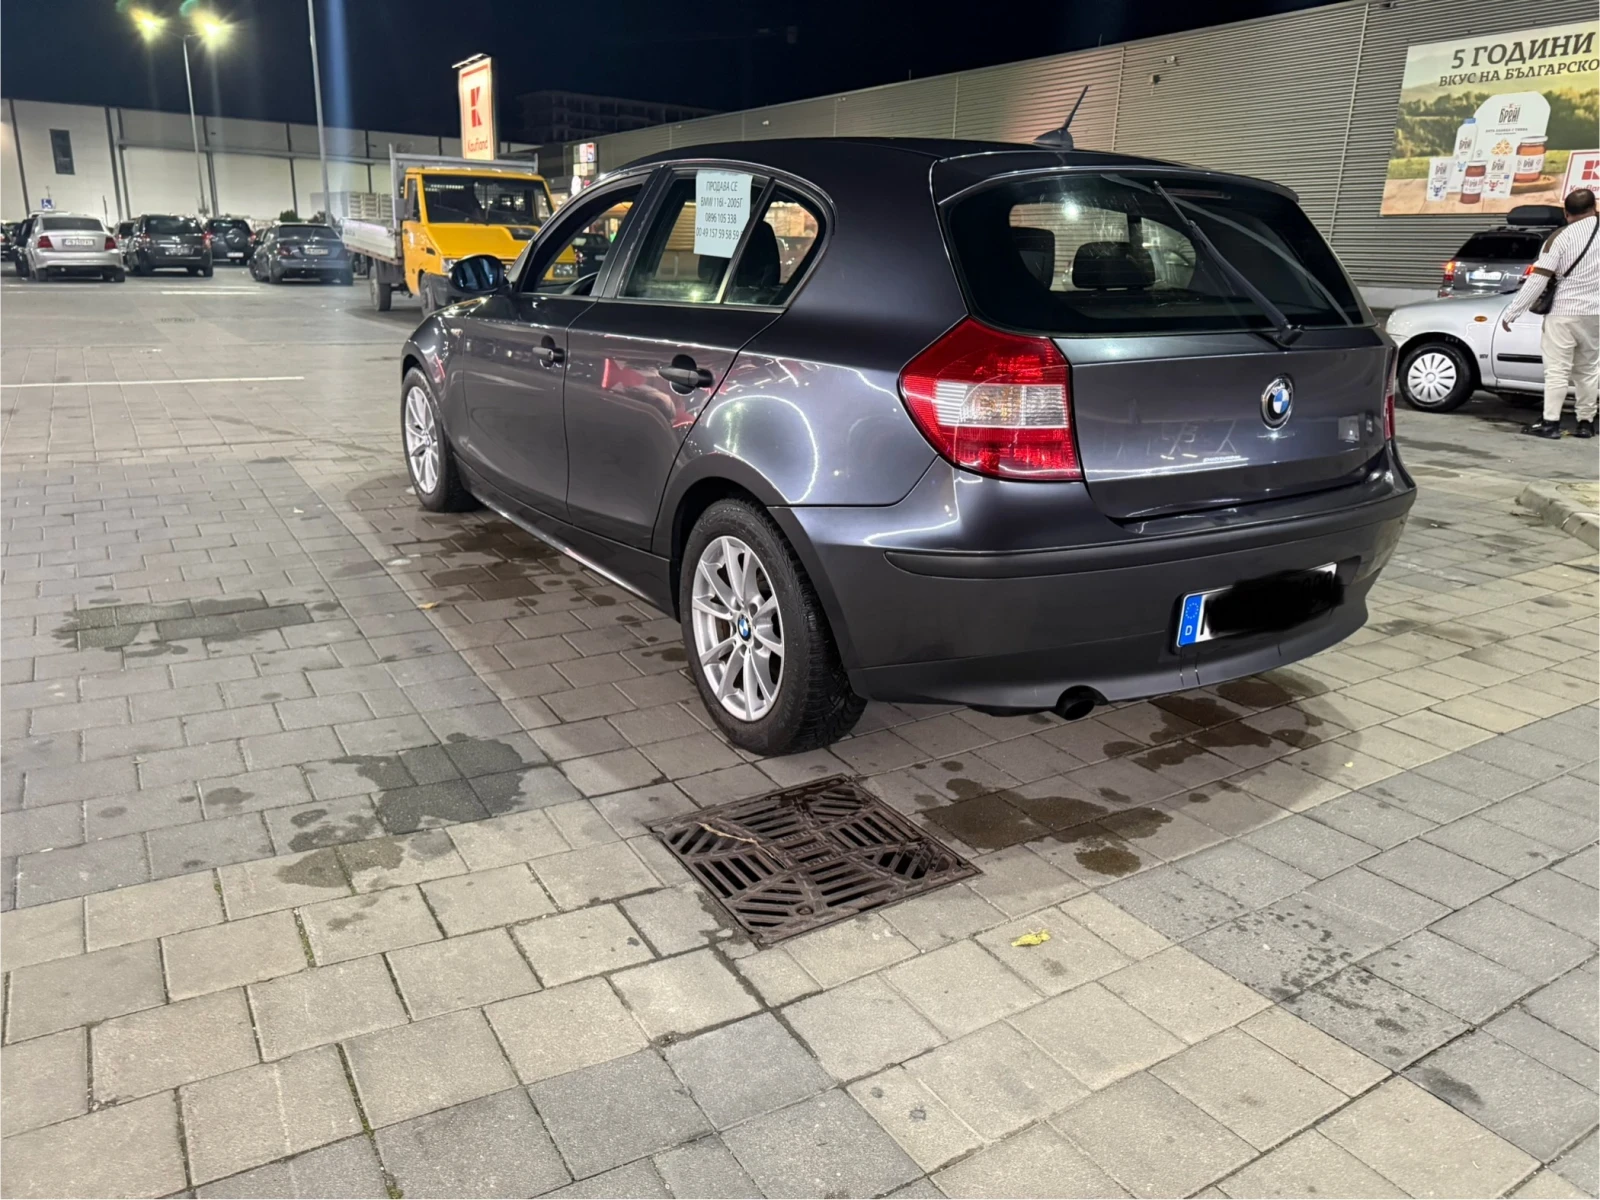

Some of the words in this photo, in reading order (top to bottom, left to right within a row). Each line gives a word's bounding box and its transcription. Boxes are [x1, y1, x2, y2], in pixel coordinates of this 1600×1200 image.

[1451, 48, 1466, 69] 5
[1471, 32, 1596, 67] ГОДИНИ
[1439, 72, 1476, 87] ВКУС
[1479, 69, 1500, 83] НА
[1504, 58, 1599, 80] БЪЛГАРСКО
[470, 86, 482, 128] K
[706, 181, 730, 193] ПРОДАВА
[730, 181, 738, 192] СЕ
[700, 197, 713, 207] BMW
[717, 213, 726, 223] 105
[702, 228, 709, 238] 49
[709, 228, 718, 239] 157
[732, 230, 739, 240] 59
[1185, 625, 1193, 636] D
